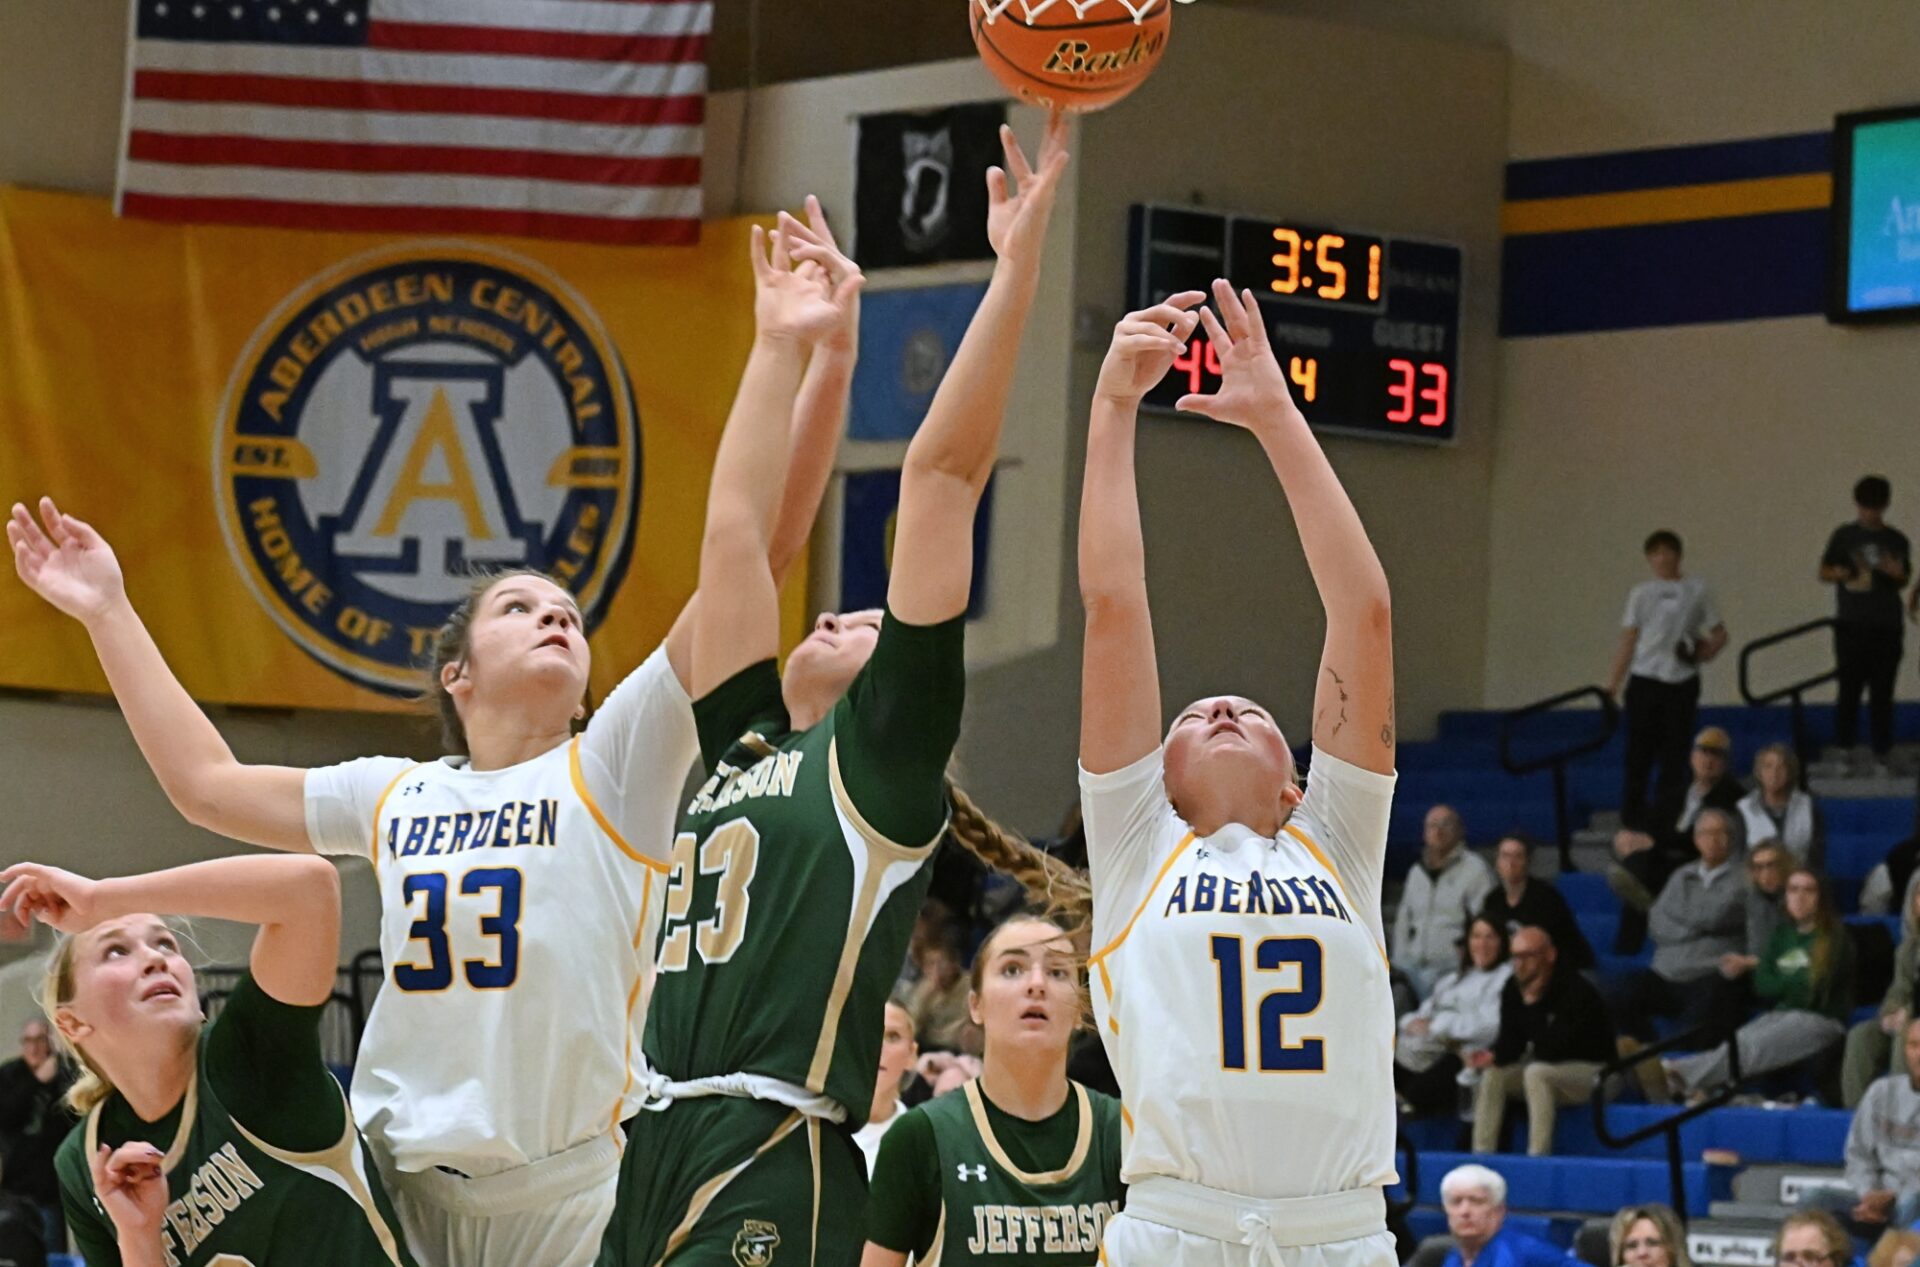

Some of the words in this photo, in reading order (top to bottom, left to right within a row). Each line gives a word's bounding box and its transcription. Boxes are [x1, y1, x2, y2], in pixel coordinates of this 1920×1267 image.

[1271, 228, 1382, 300] 3:51
[258, 272, 454, 423] ABERDEEN
[470, 278, 602, 427] CENTRAL
[1290, 356, 1318, 403] 4
[1386, 358, 1448, 427] 33
[249, 496, 336, 615] HOME
[336, 604, 393, 648] OF
[387, 799, 558, 860] ABERDEEN
[392, 863, 527, 994] 33
[655, 816, 760, 974] 23
[1208, 932, 1327, 1074] 12
[967, 1199, 1119, 1255] JEFFERSO
